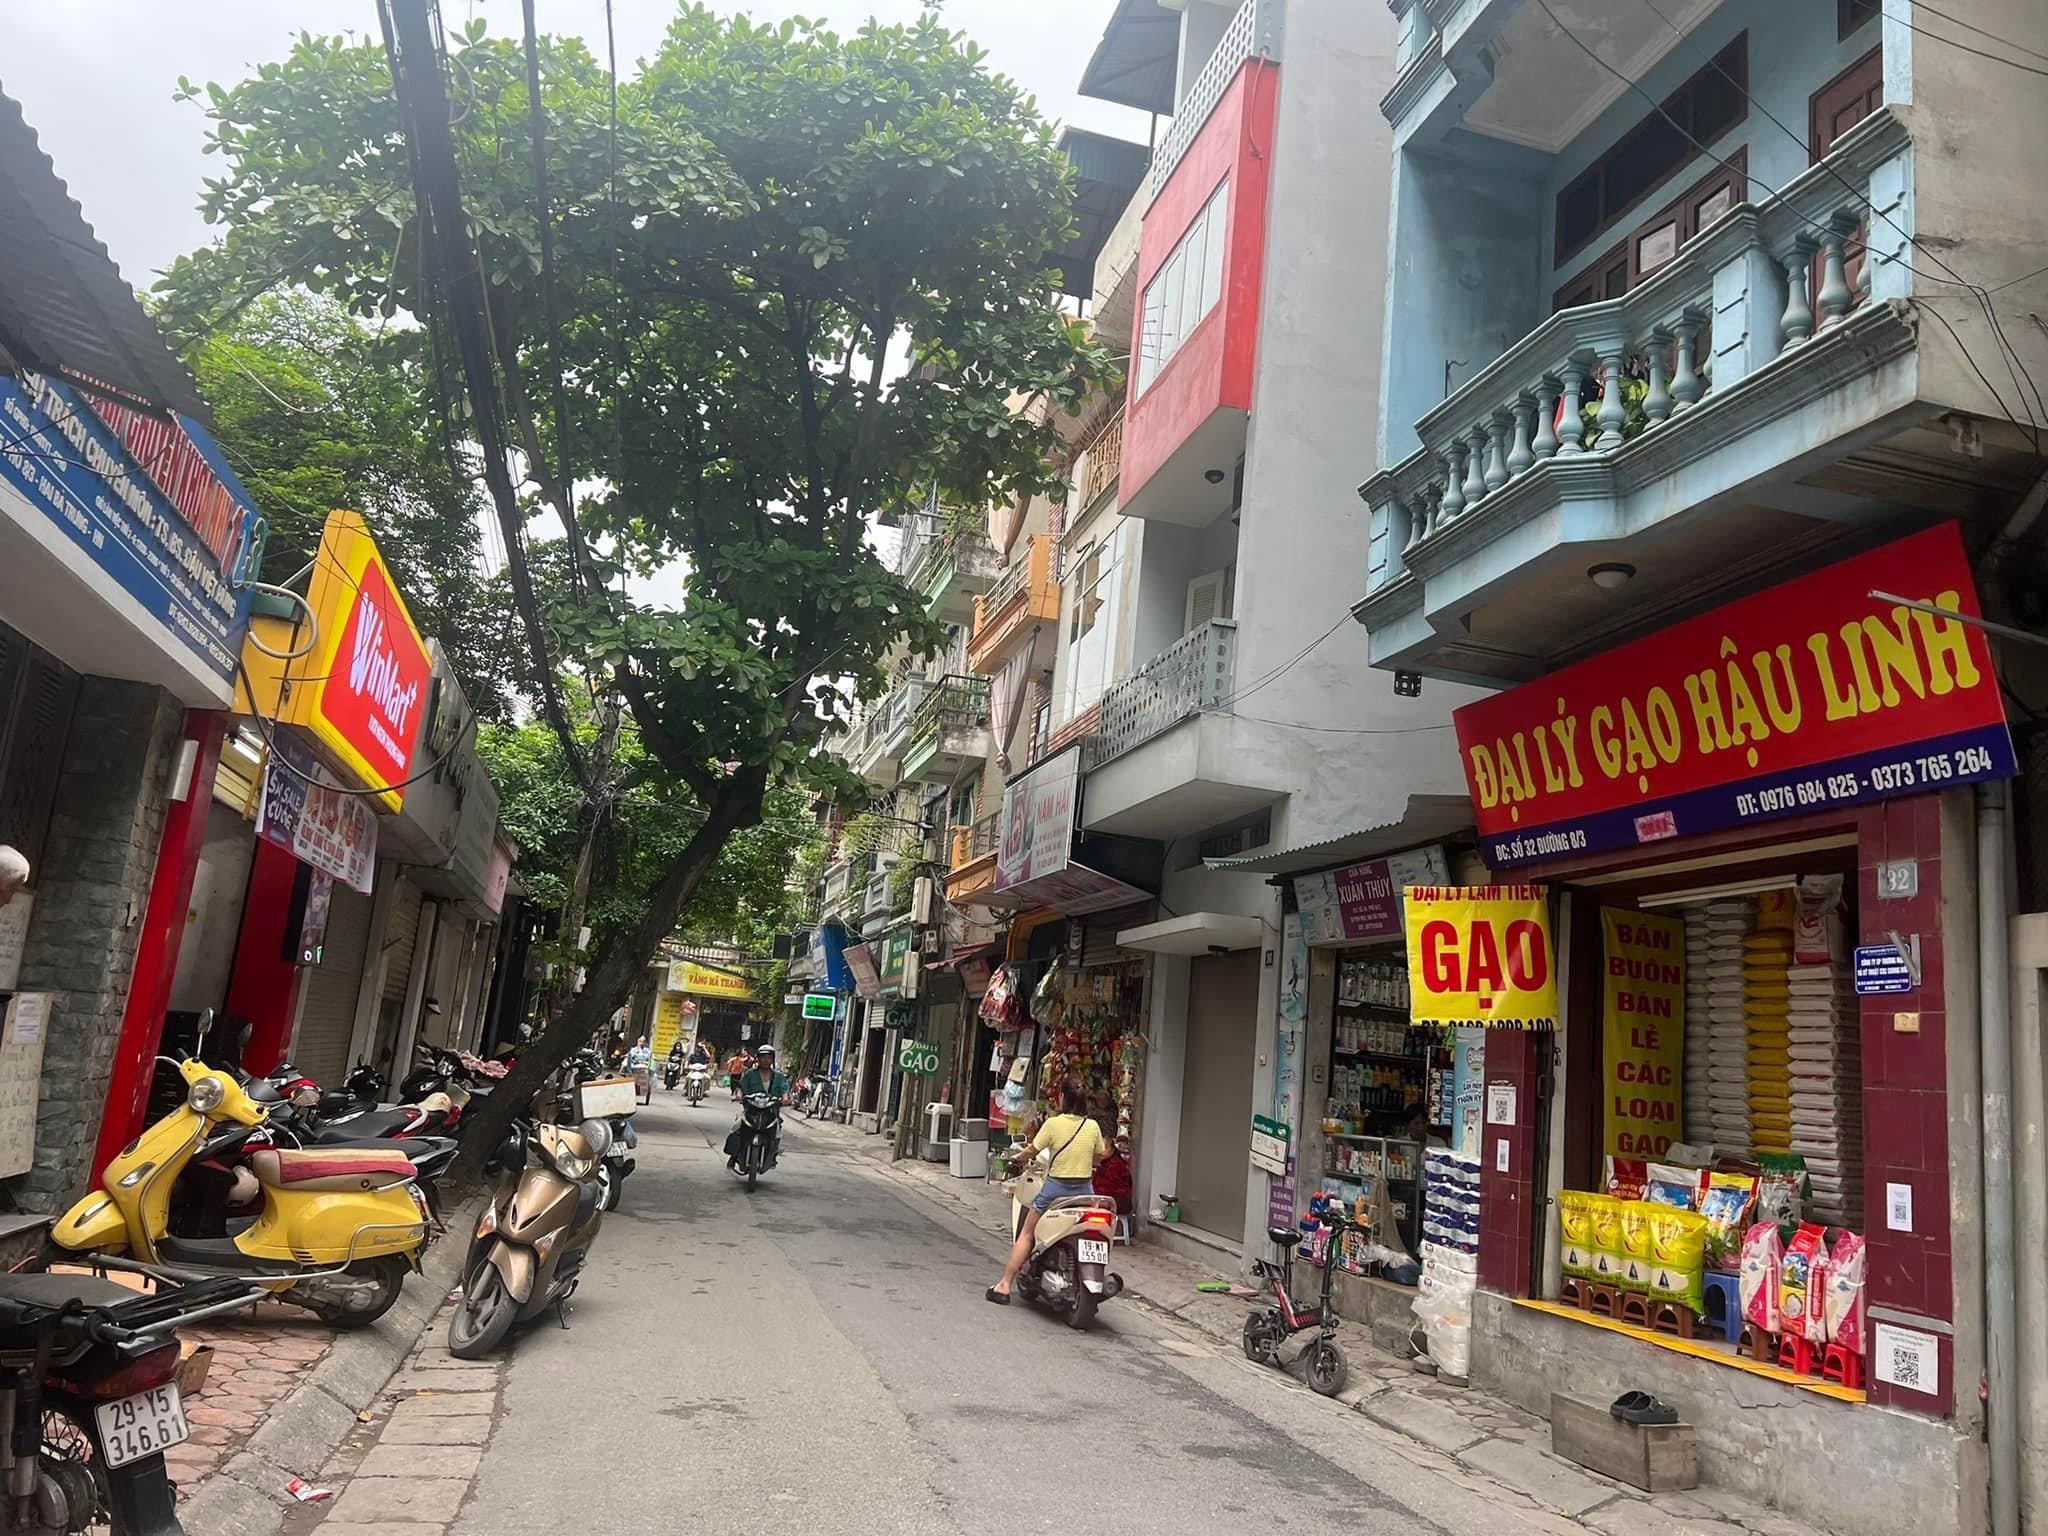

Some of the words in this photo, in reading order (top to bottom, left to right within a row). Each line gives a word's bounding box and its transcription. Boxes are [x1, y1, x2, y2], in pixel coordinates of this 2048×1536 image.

[45, 386, 87, 453] TRÁCH
[86, 437, 130, 500] CHUYÊN
[38, 475, 55, 502] HAI
[1471, 732, 1536, 822] ĐẠI
[1534, 697, 1584, 794] LÝ
[1590, 686, 1681, 794] GẠO
[1683, 635, 1802, 768] HẬU
[1807, 590, 1980, 721] LINH
[1736, 793, 1759, 817] ĐT:
[1759, 785, 1795, 812] 0976
[1796, 779, 1825, 805] 684
[1829, 773, 1858, 798] 825
[1871, 762, 1915, 791] 0373
[1916, 755, 1953, 783] 765
[1955, 746, 1993, 776] 264
[1511, 834, 1524, 859] SỐ
[1524, 839, 1537, 858] 32
[1570, 830, 1587, 849] 8/3
[1887, 867, 1910, 891] 32
[1616, 923, 1671, 949] BÁN
[1420, 919, 1547, 1010] GẠO
[1608, 956, 1681, 985] BUÔN
[1617, 990, 1672, 1018] BÁN
[1631, 1024, 1659, 1050] LẺ
[900, 1050, 939, 1073] GẠO
[1616, 1061, 1672, 1086] CÁC
[1615, 1096, 1674, 1125] LOẠI
[1617, 1132, 1672, 1158] GẠO
[110, 1388, 171, 1431] 29-Y5
[109, 1413, 183, 1458] 346.61
